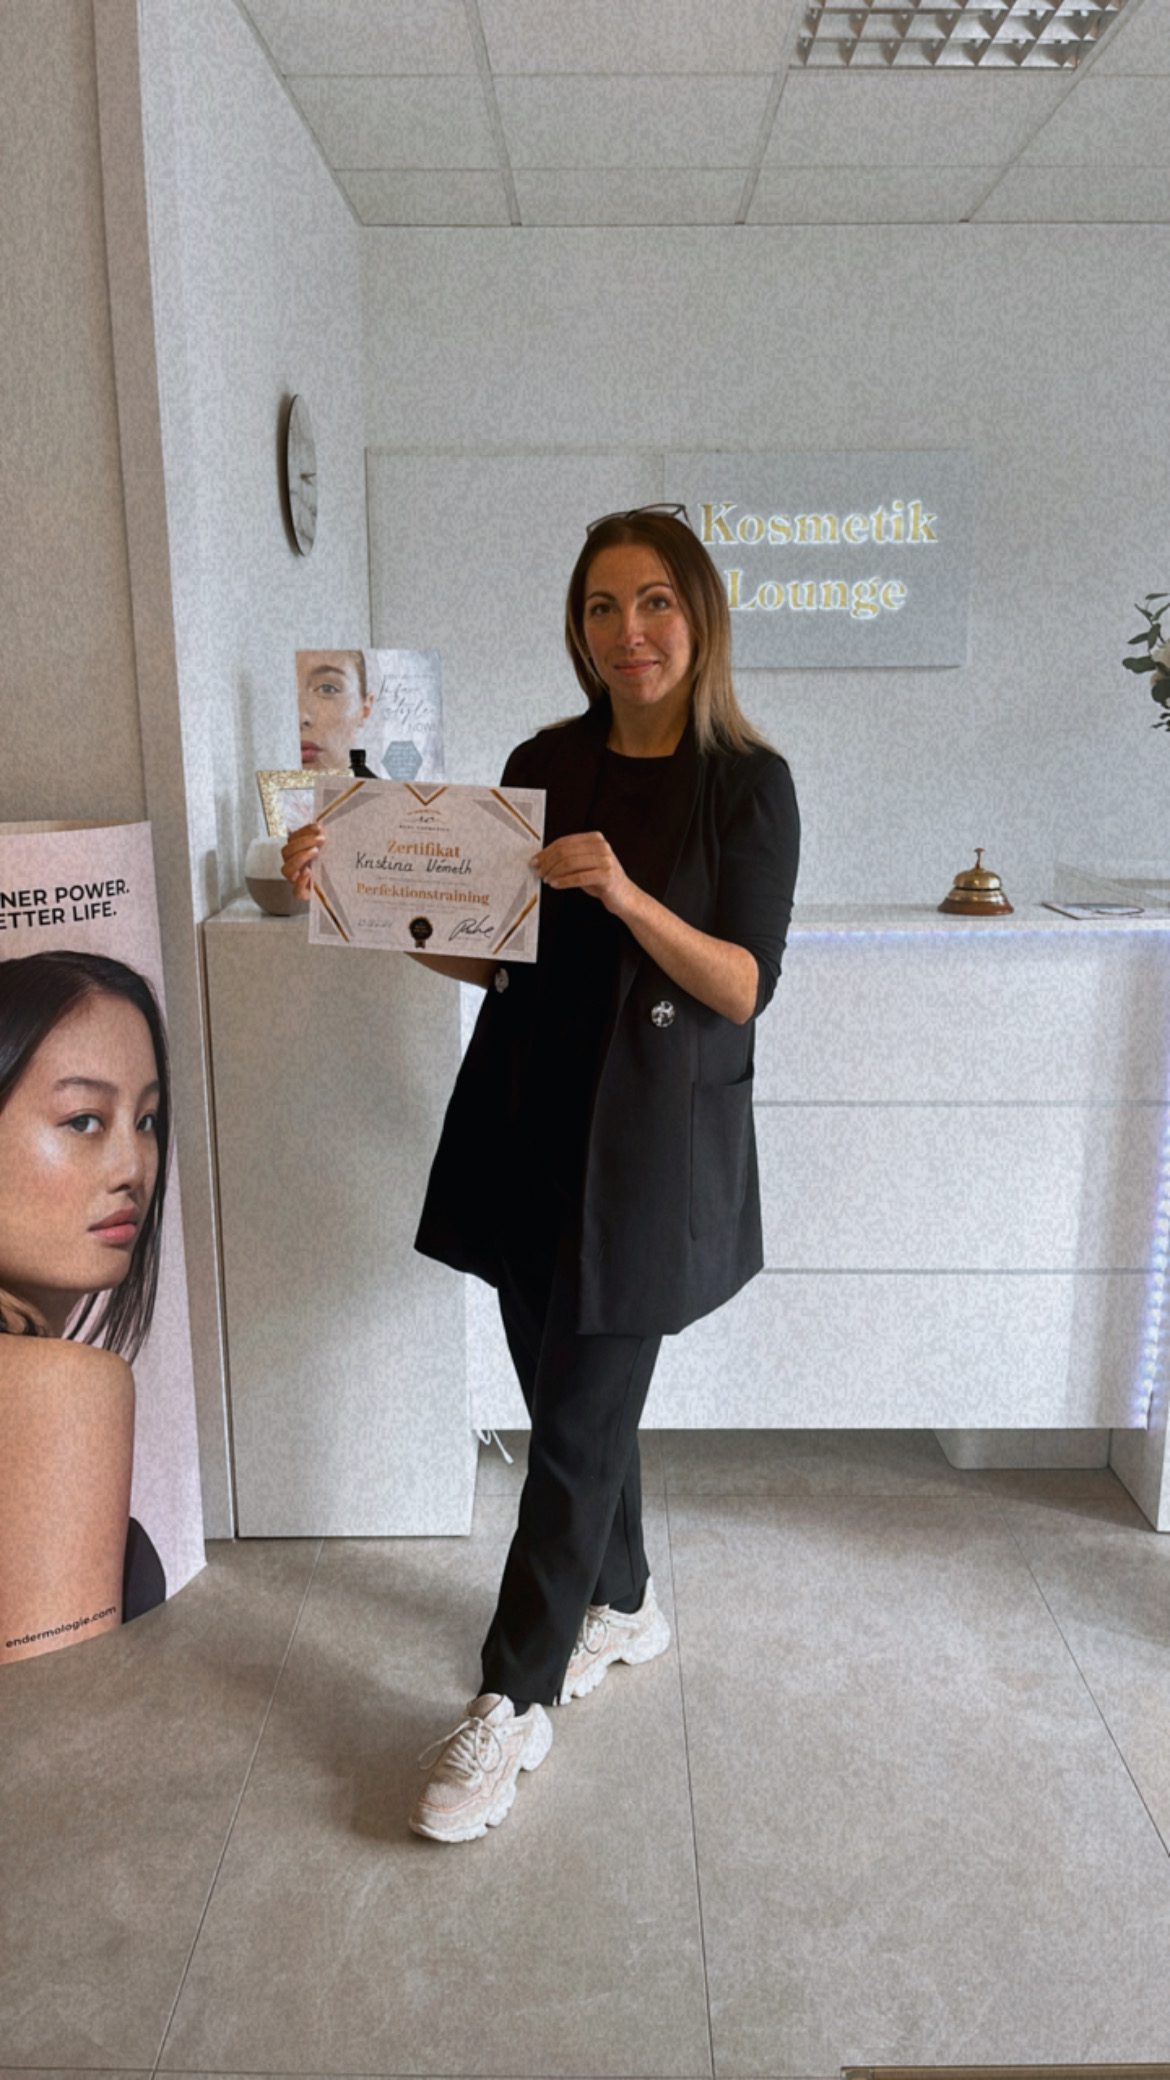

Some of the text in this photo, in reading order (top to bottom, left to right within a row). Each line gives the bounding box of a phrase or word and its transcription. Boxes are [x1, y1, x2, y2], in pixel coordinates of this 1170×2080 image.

[699, 501, 938, 544] Kosmetik
[725, 568, 908, 619] Lounge
[387, 840, 460, 858] Zertifikat
[355, 851, 413, 873] Kristina
[55, 878, 130, 903] POWER.
[356, 881, 490, 906] Perfektionstraining
[73, 901, 117, 922] LIFE.
[5, 1606, 117, 1648] endermologie.com
